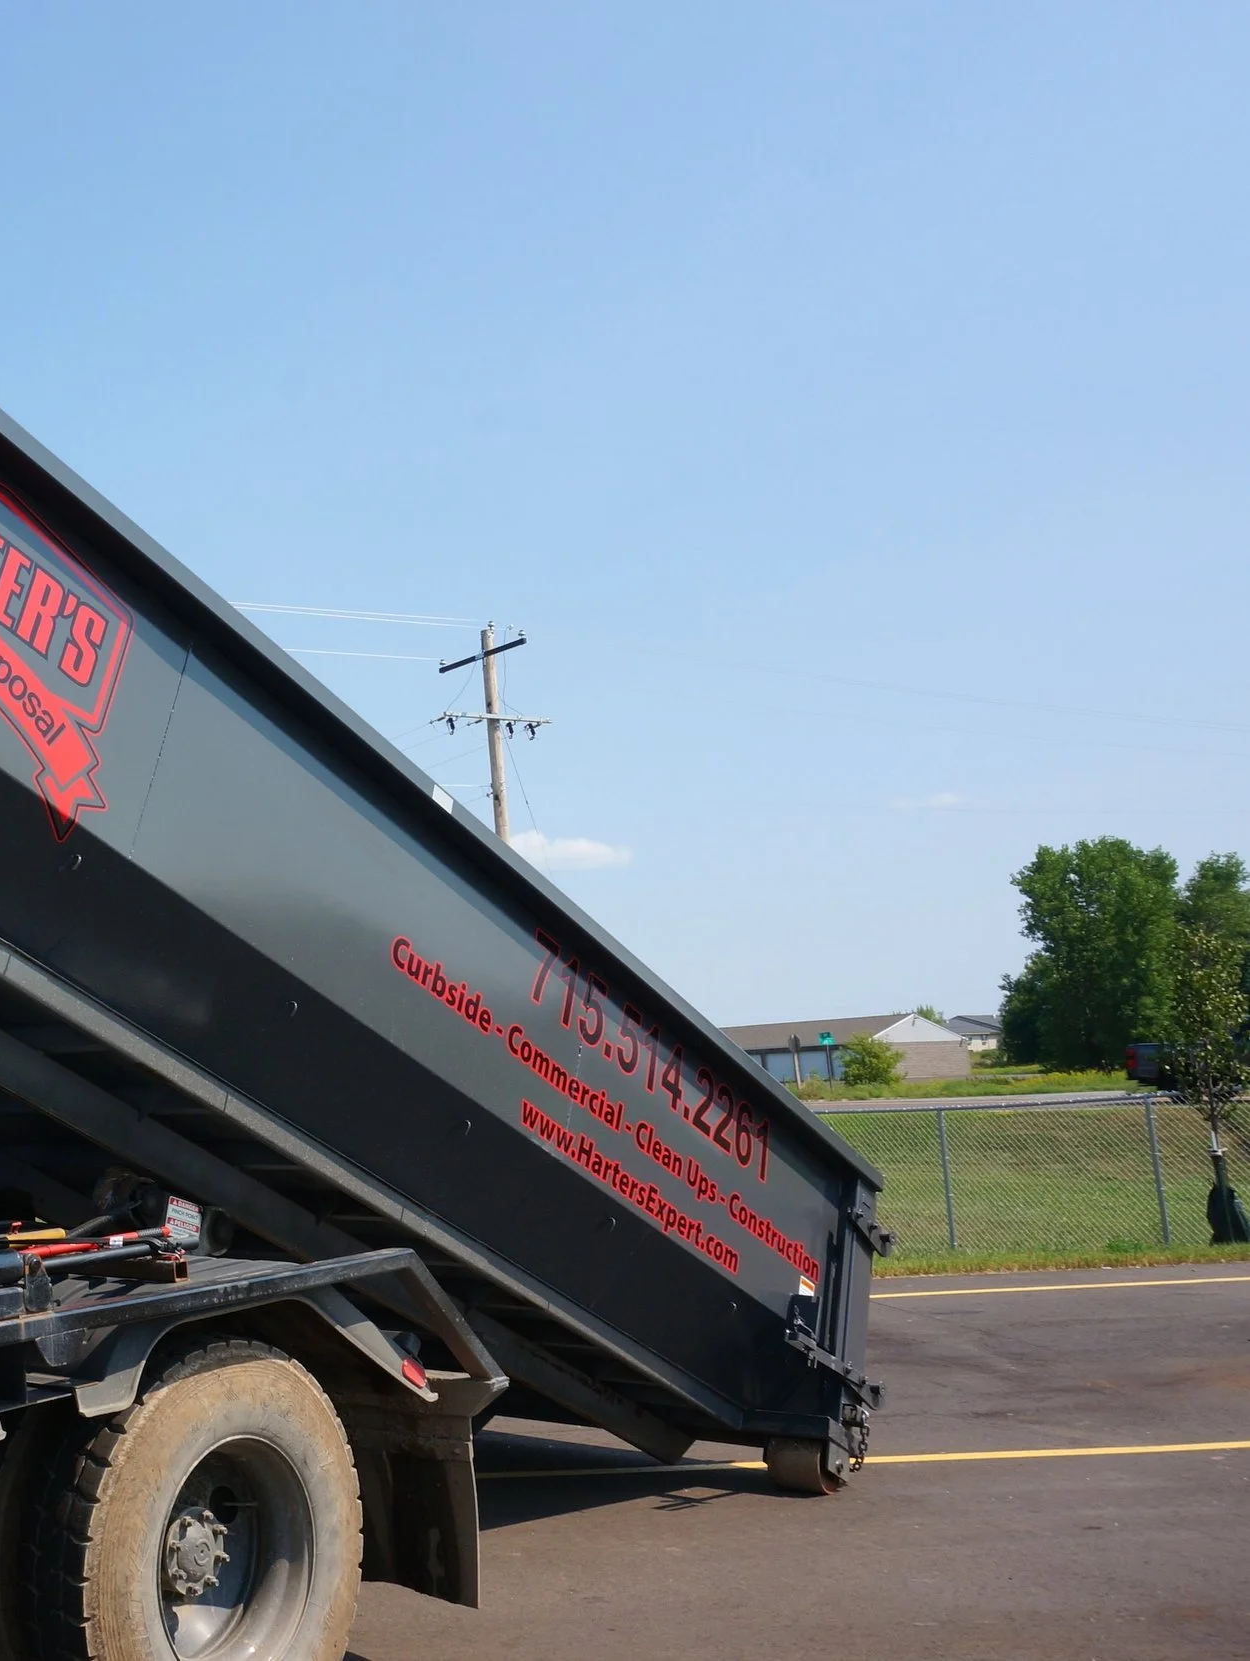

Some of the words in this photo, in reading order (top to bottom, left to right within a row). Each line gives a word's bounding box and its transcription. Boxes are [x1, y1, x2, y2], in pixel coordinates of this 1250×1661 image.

[390, 935, 494, 1036] Curbside
[506, 1024, 626, 1133] Commercial
[634, 1121, 685, 1178] Clean
[685, 1155, 718, 1204] Ups
[727, 1192, 821, 1283] Construction
[530, 928, 771, 1182] 715.514.2261
[520, 1098, 740, 1275] www.HartersExpert.com
